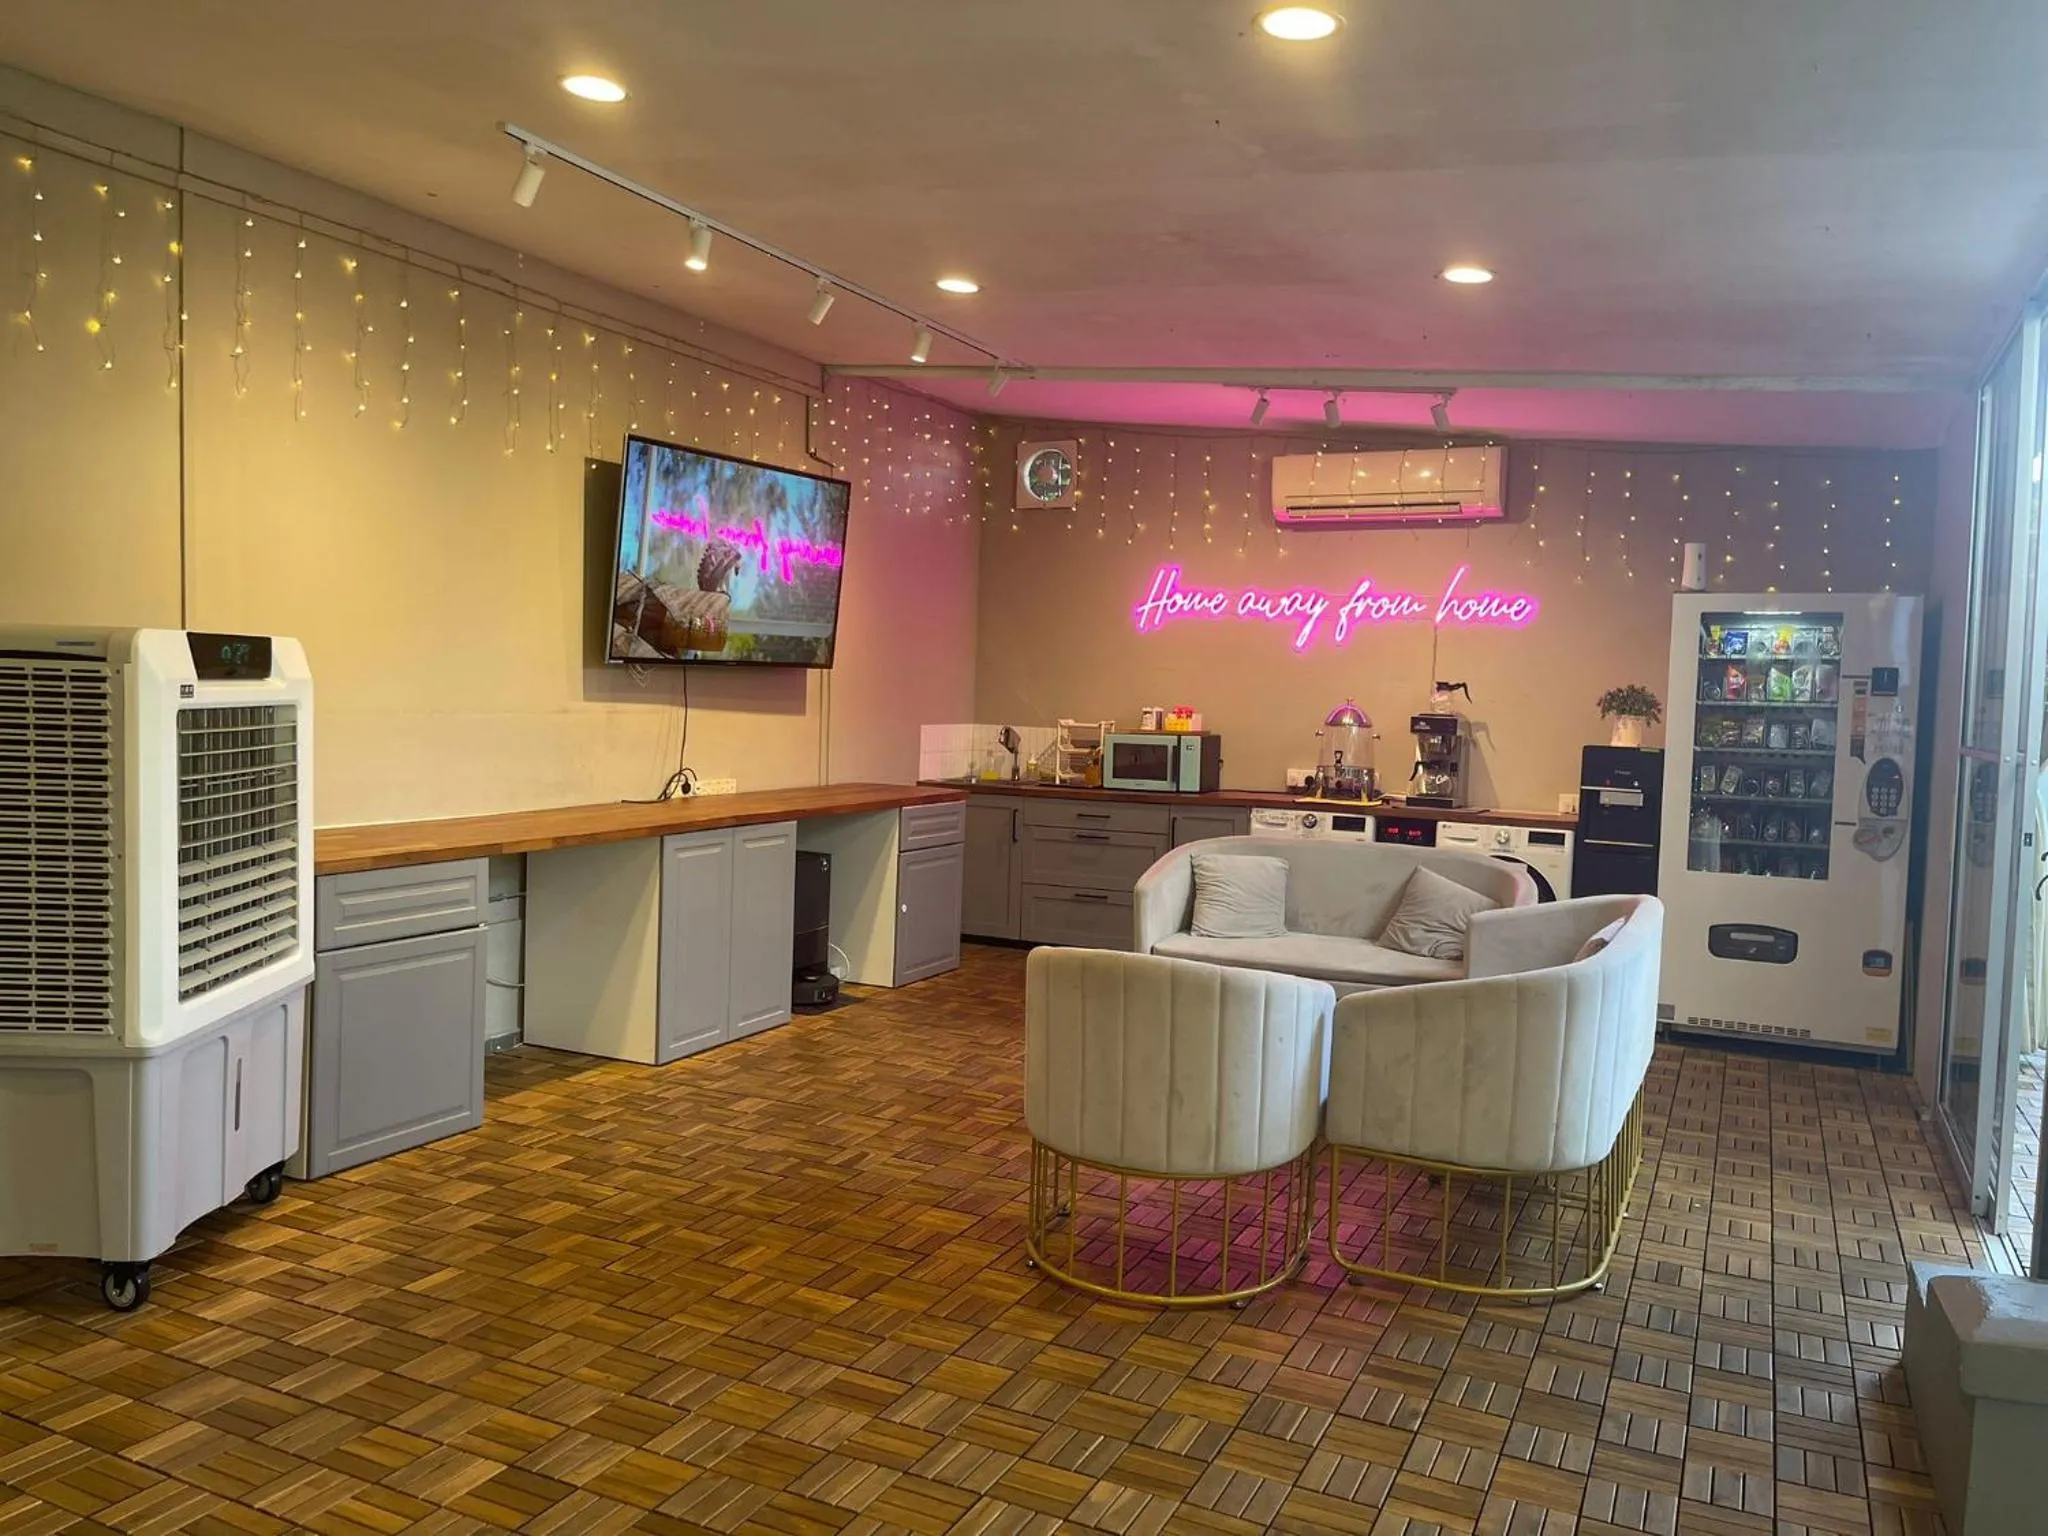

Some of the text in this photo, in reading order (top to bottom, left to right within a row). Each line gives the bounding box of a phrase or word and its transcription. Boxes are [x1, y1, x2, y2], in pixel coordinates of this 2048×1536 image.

[1137, 566, 1532, 648] Home away from home
